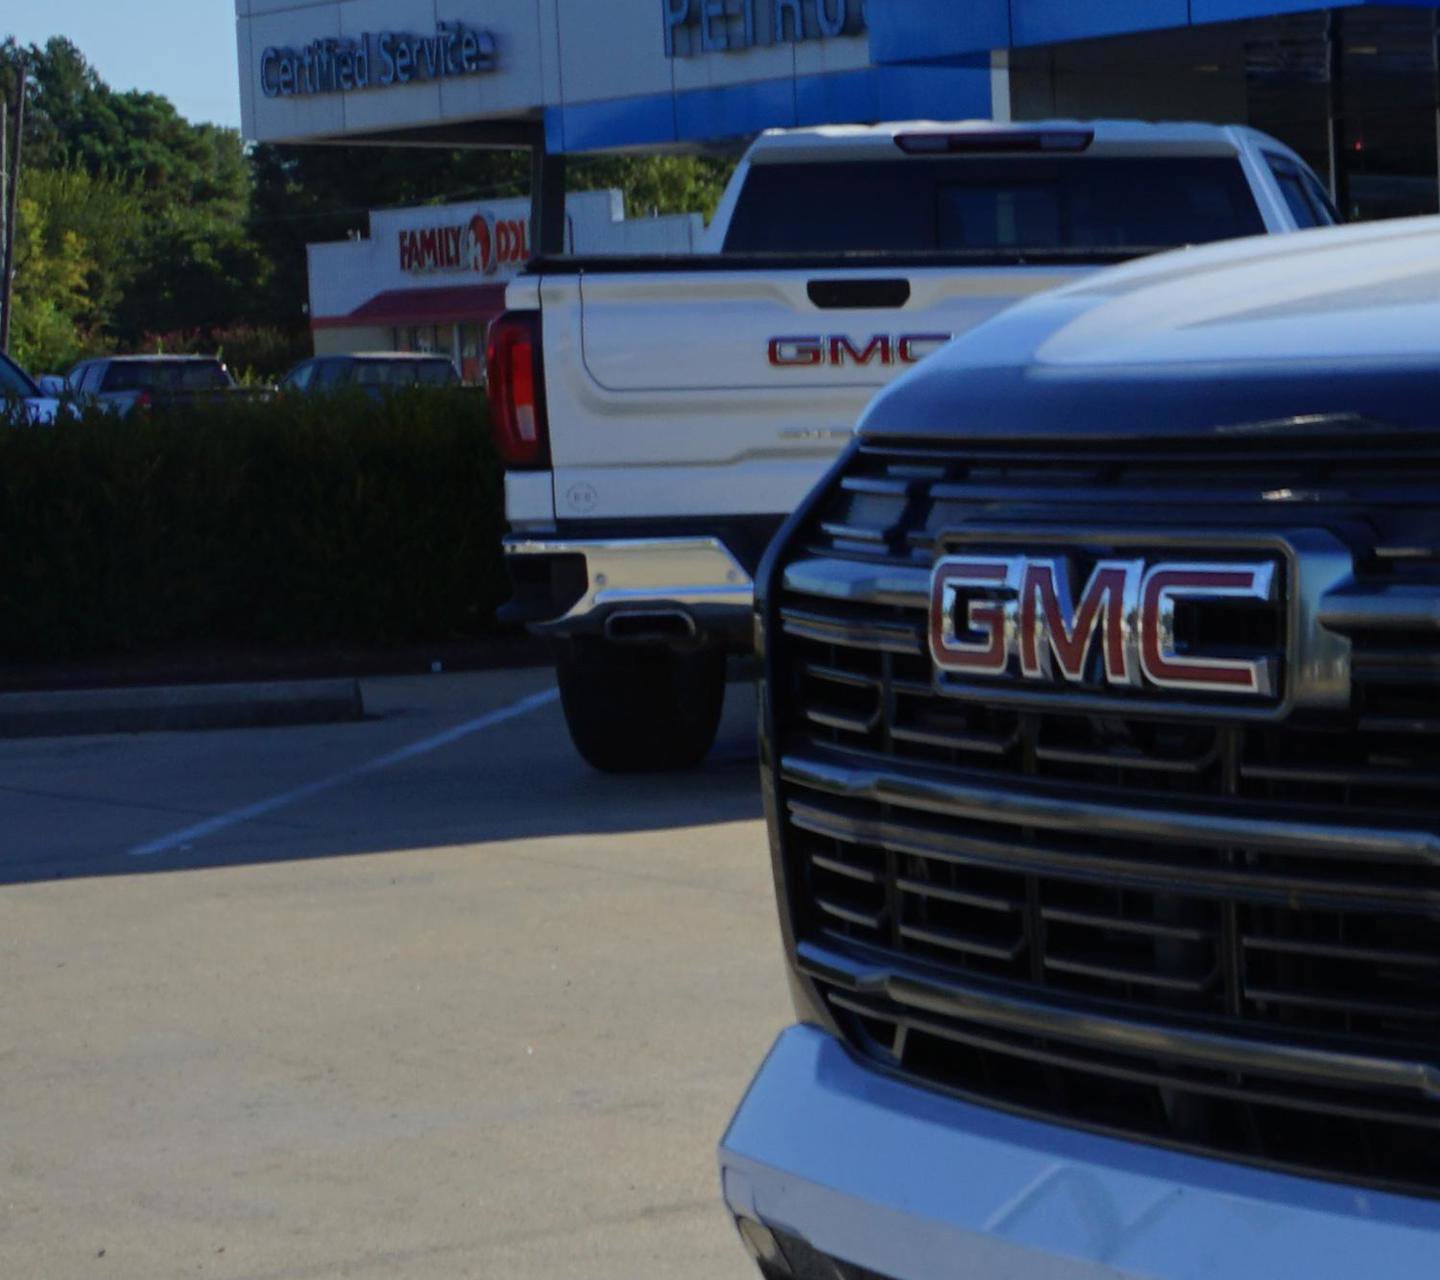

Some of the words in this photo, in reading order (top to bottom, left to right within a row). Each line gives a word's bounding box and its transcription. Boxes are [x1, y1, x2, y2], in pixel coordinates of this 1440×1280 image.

[261, 32, 369, 98] Certified
[378, 20, 484, 87] Service
[399, 226, 462, 271] FAMILY
[767, 331, 954, 368] GMC
[930, 553, 1276, 697] GMC
